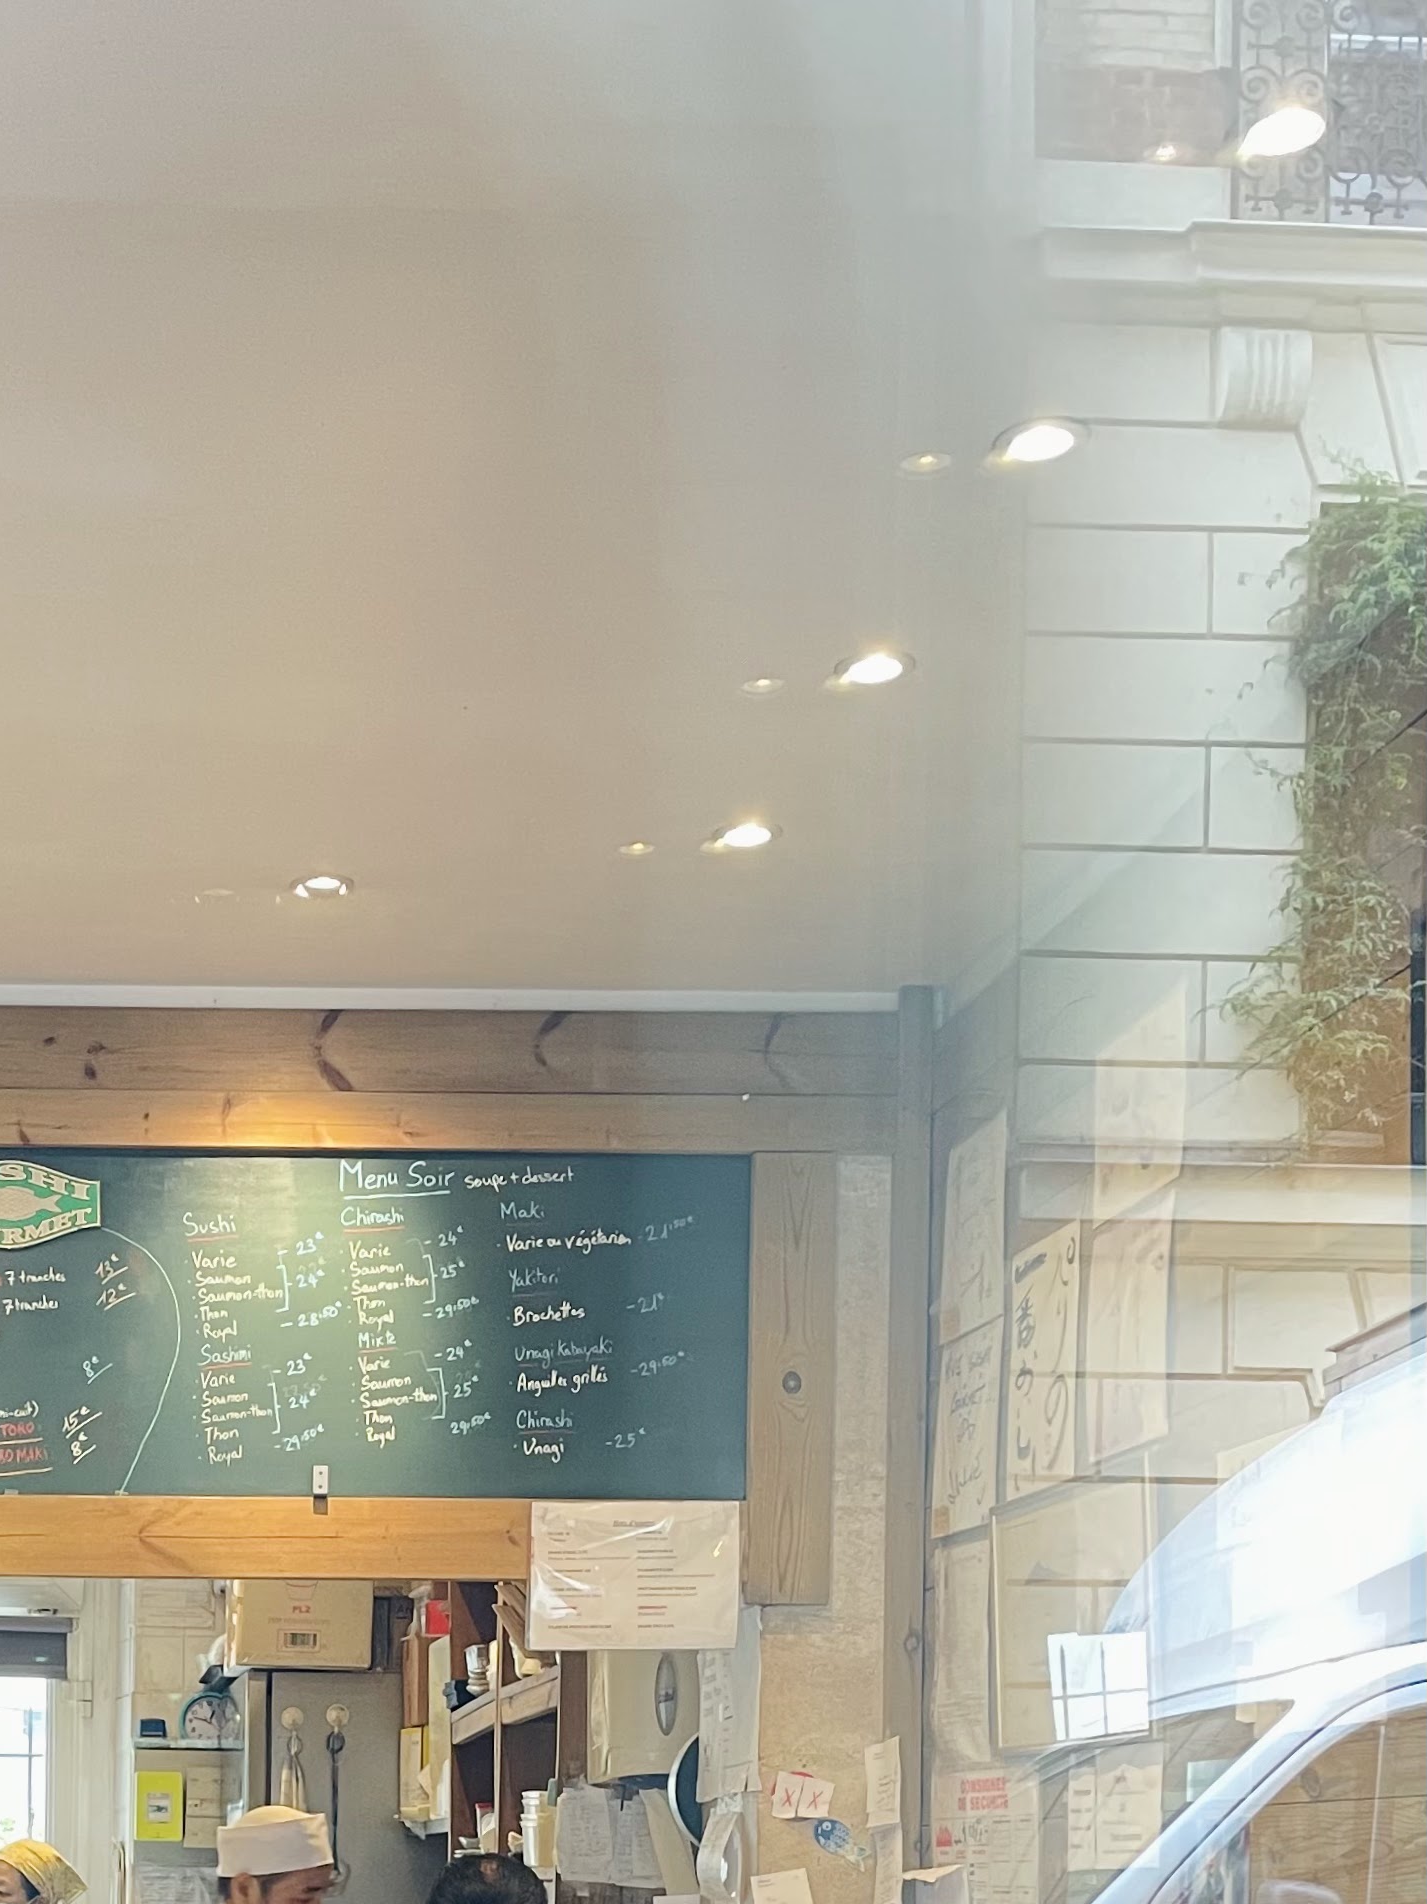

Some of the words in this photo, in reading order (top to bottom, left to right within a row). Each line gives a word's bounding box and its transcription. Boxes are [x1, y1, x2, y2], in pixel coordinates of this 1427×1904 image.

[339, 1159, 399, 1191] Menu
[406, 1160, 455, 1188] Soir
[521, 1166, 574, 1185] dessert
[340, 1206, 405, 1227] Chirashi
[500, 1200, 545, 1220] Maki
[182, 1212, 237, 1237] Sushi
[4, 1270, 15, 1286] 7
[509, 1265, 561, 1293] Yakitori
[2, 1299, 15, 1316] 7
[199, 1306, 229, 1322] Thon
[353, 1296, 386, 1314] Thon
[512, 1300, 586, 1327] Brochettes
[203, 1319, 239, 1343] Royal
[358, 1309, 396, 1333] Royal
[358, 1331, 396, 1349] Mixte
[197, 1343, 253, 1366] Sashimi
[514, 1343, 554, 1370] Unagi
[363, 1410, 394, 1426] Thon
[516, 1408, 573, 1430] Chirashi
[204, 1426, 240, 1444] Thon
[365, 1426, 396, 1449] Royal
[207, 1444, 243, 1466] Royal
[523, 1437, 565, 1463] Unagi
